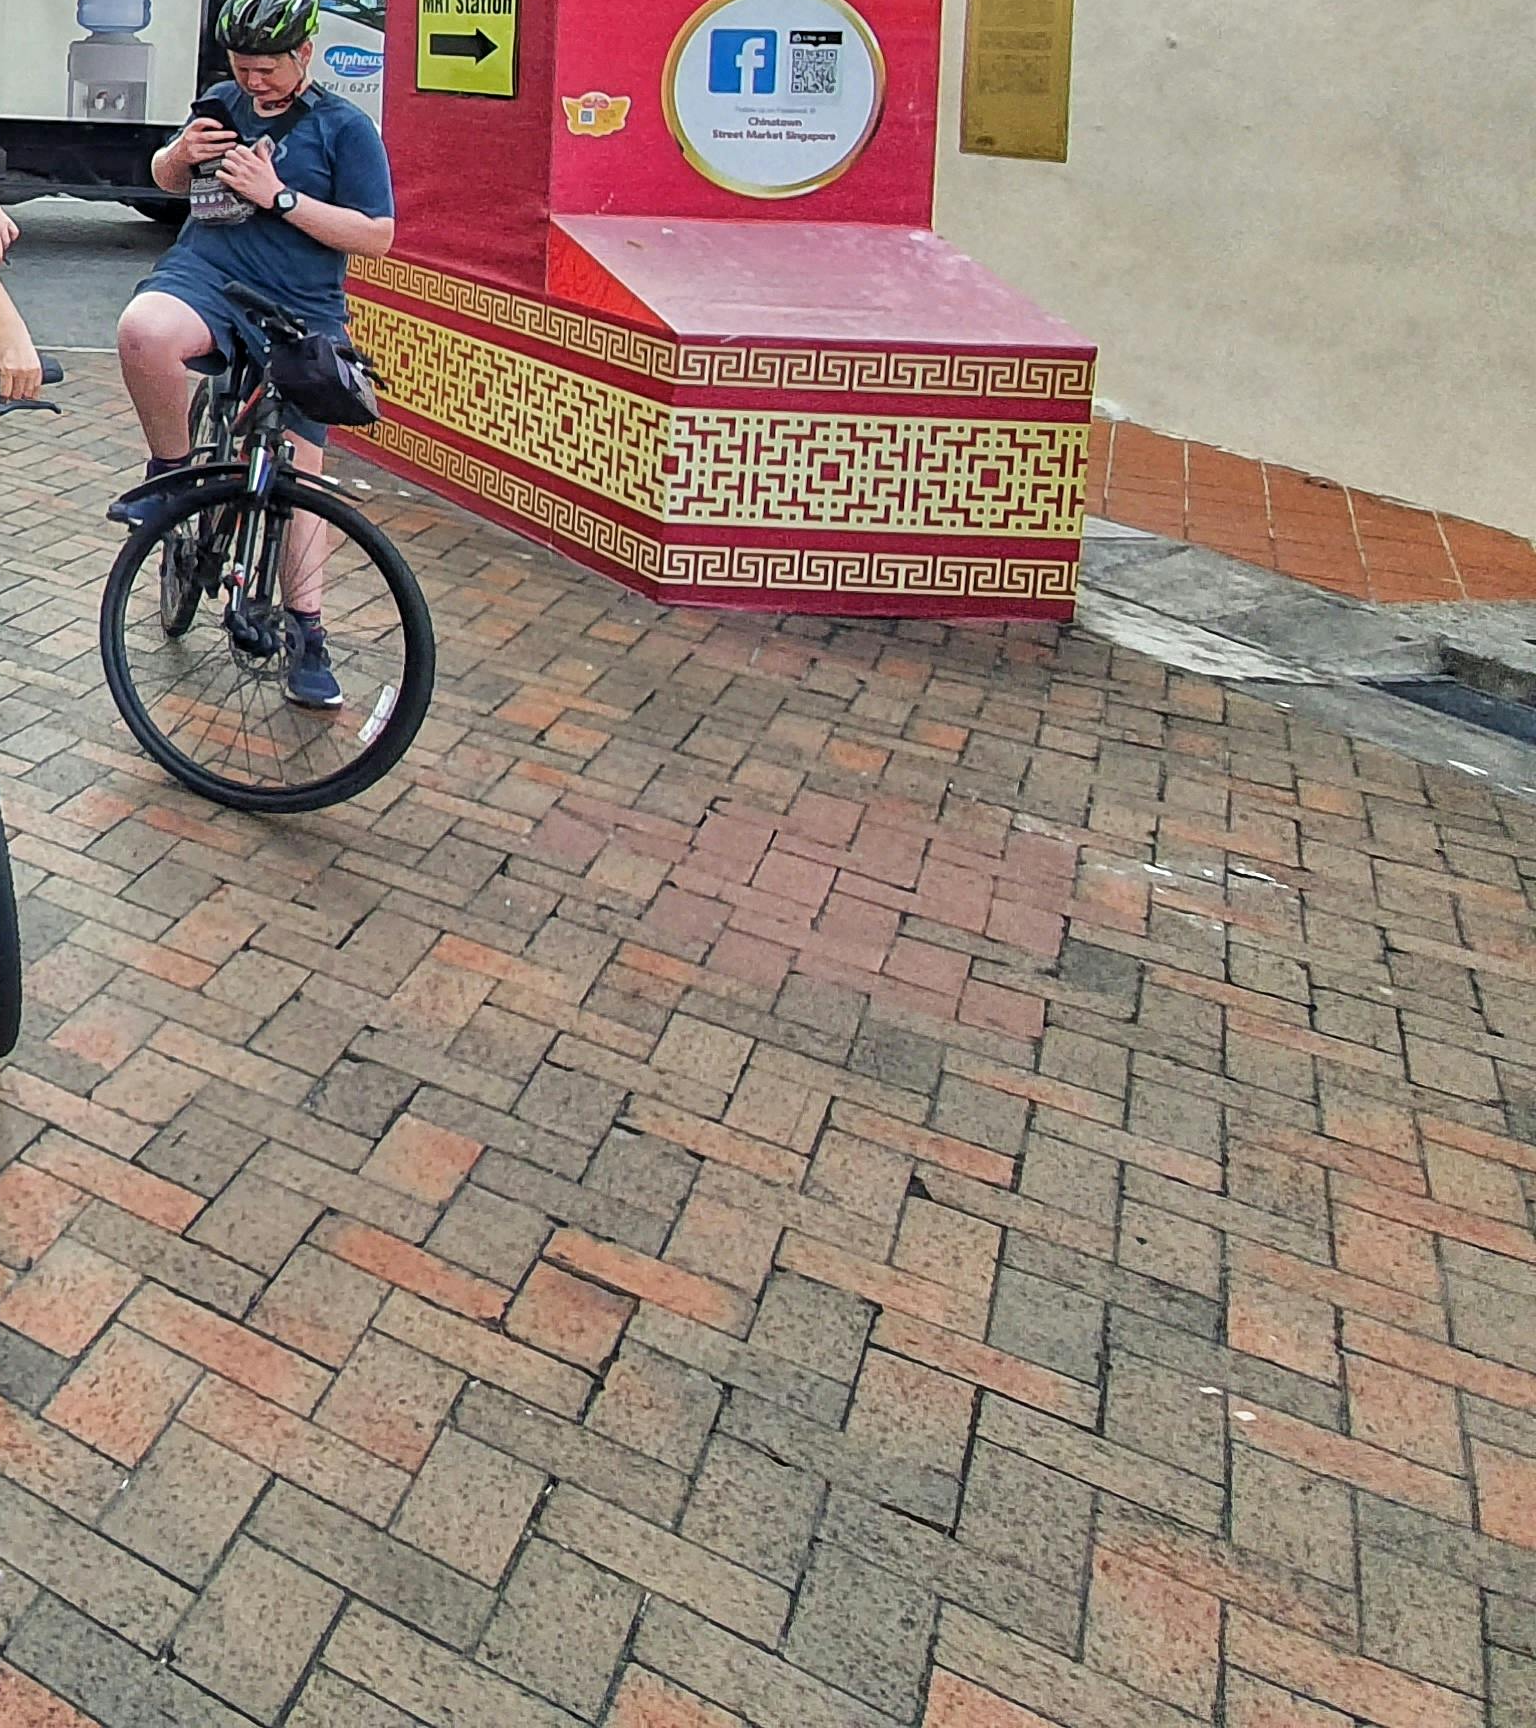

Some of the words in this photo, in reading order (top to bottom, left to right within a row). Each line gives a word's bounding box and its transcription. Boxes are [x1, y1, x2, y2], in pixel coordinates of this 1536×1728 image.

[326, 51, 384, 71] Alpheus
[748, 116, 803, 127] Chinatown
[712, 129, 744, 139] Street
[746, 129, 783, 140] Market
[785, 130, 836, 143] Singapore
